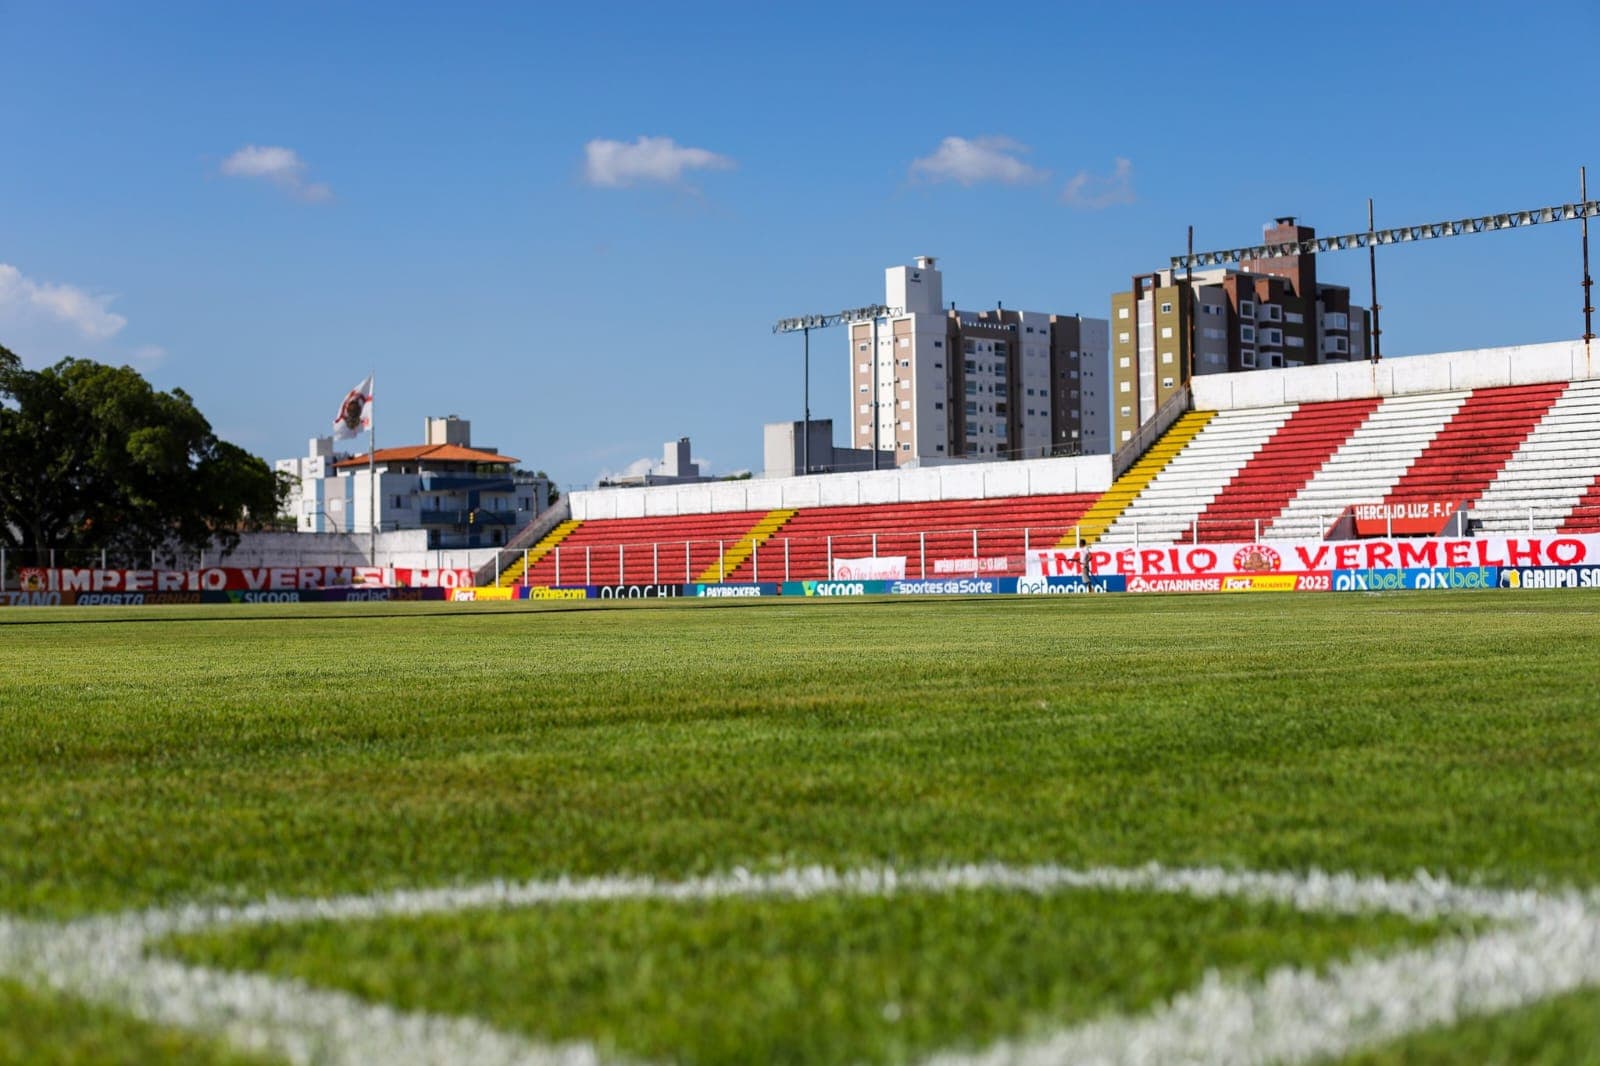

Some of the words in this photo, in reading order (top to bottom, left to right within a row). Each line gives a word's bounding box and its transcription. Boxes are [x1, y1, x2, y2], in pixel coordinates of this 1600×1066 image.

[1407, 503, 1429, 518] LUZ
[1038, 547, 1218, 577] IMPÉRIO
[1294, 538, 1586, 572] VERMELHO
[1149, 578, 1220, 592] CATARINENSE
[1225, 578, 1252, 590] Fort
[1298, 576, 1329, 590] 2023
[1336, 568, 1405, 591] pixbet
[1415, 567, 1489, 590] pixbet
[1522, 568, 1578, 588] GRUPO
[601, 585, 676, 599] OGOCHI
[706, 586, 761, 597] PAYBROKERS
[817, 583, 864, 596] SICOOB
[78, 593, 145, 605] APOSTA
[244, 591, 299, 603] SICOOB
